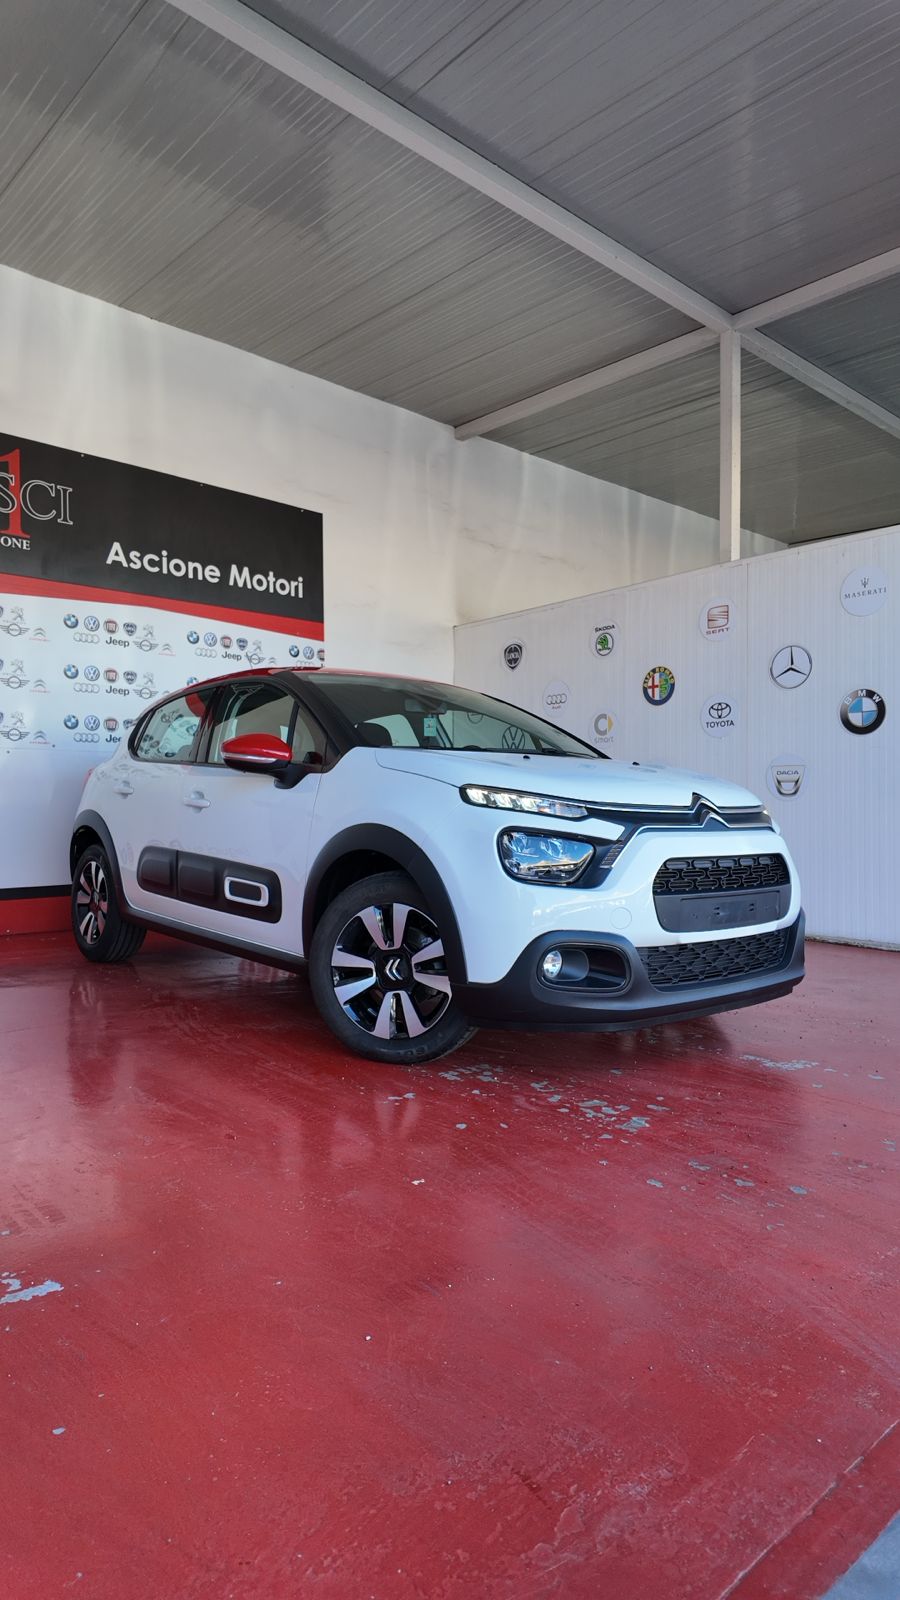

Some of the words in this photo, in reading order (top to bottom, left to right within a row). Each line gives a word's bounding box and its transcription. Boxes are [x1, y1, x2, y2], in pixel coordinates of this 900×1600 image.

[106, 541, 221, 583] Ascione
[229, 564, 304, 598] Motori
[844, 587, 887, 599] MASERATI
[706, 627, 730, 635] SEAT
[105, 636, 130, 648] Jeep
[221, 651, 242, 662] Jeep
[105, 686, 130, 697] Jeep
[705, 720, 735, 729] TOYOTA
